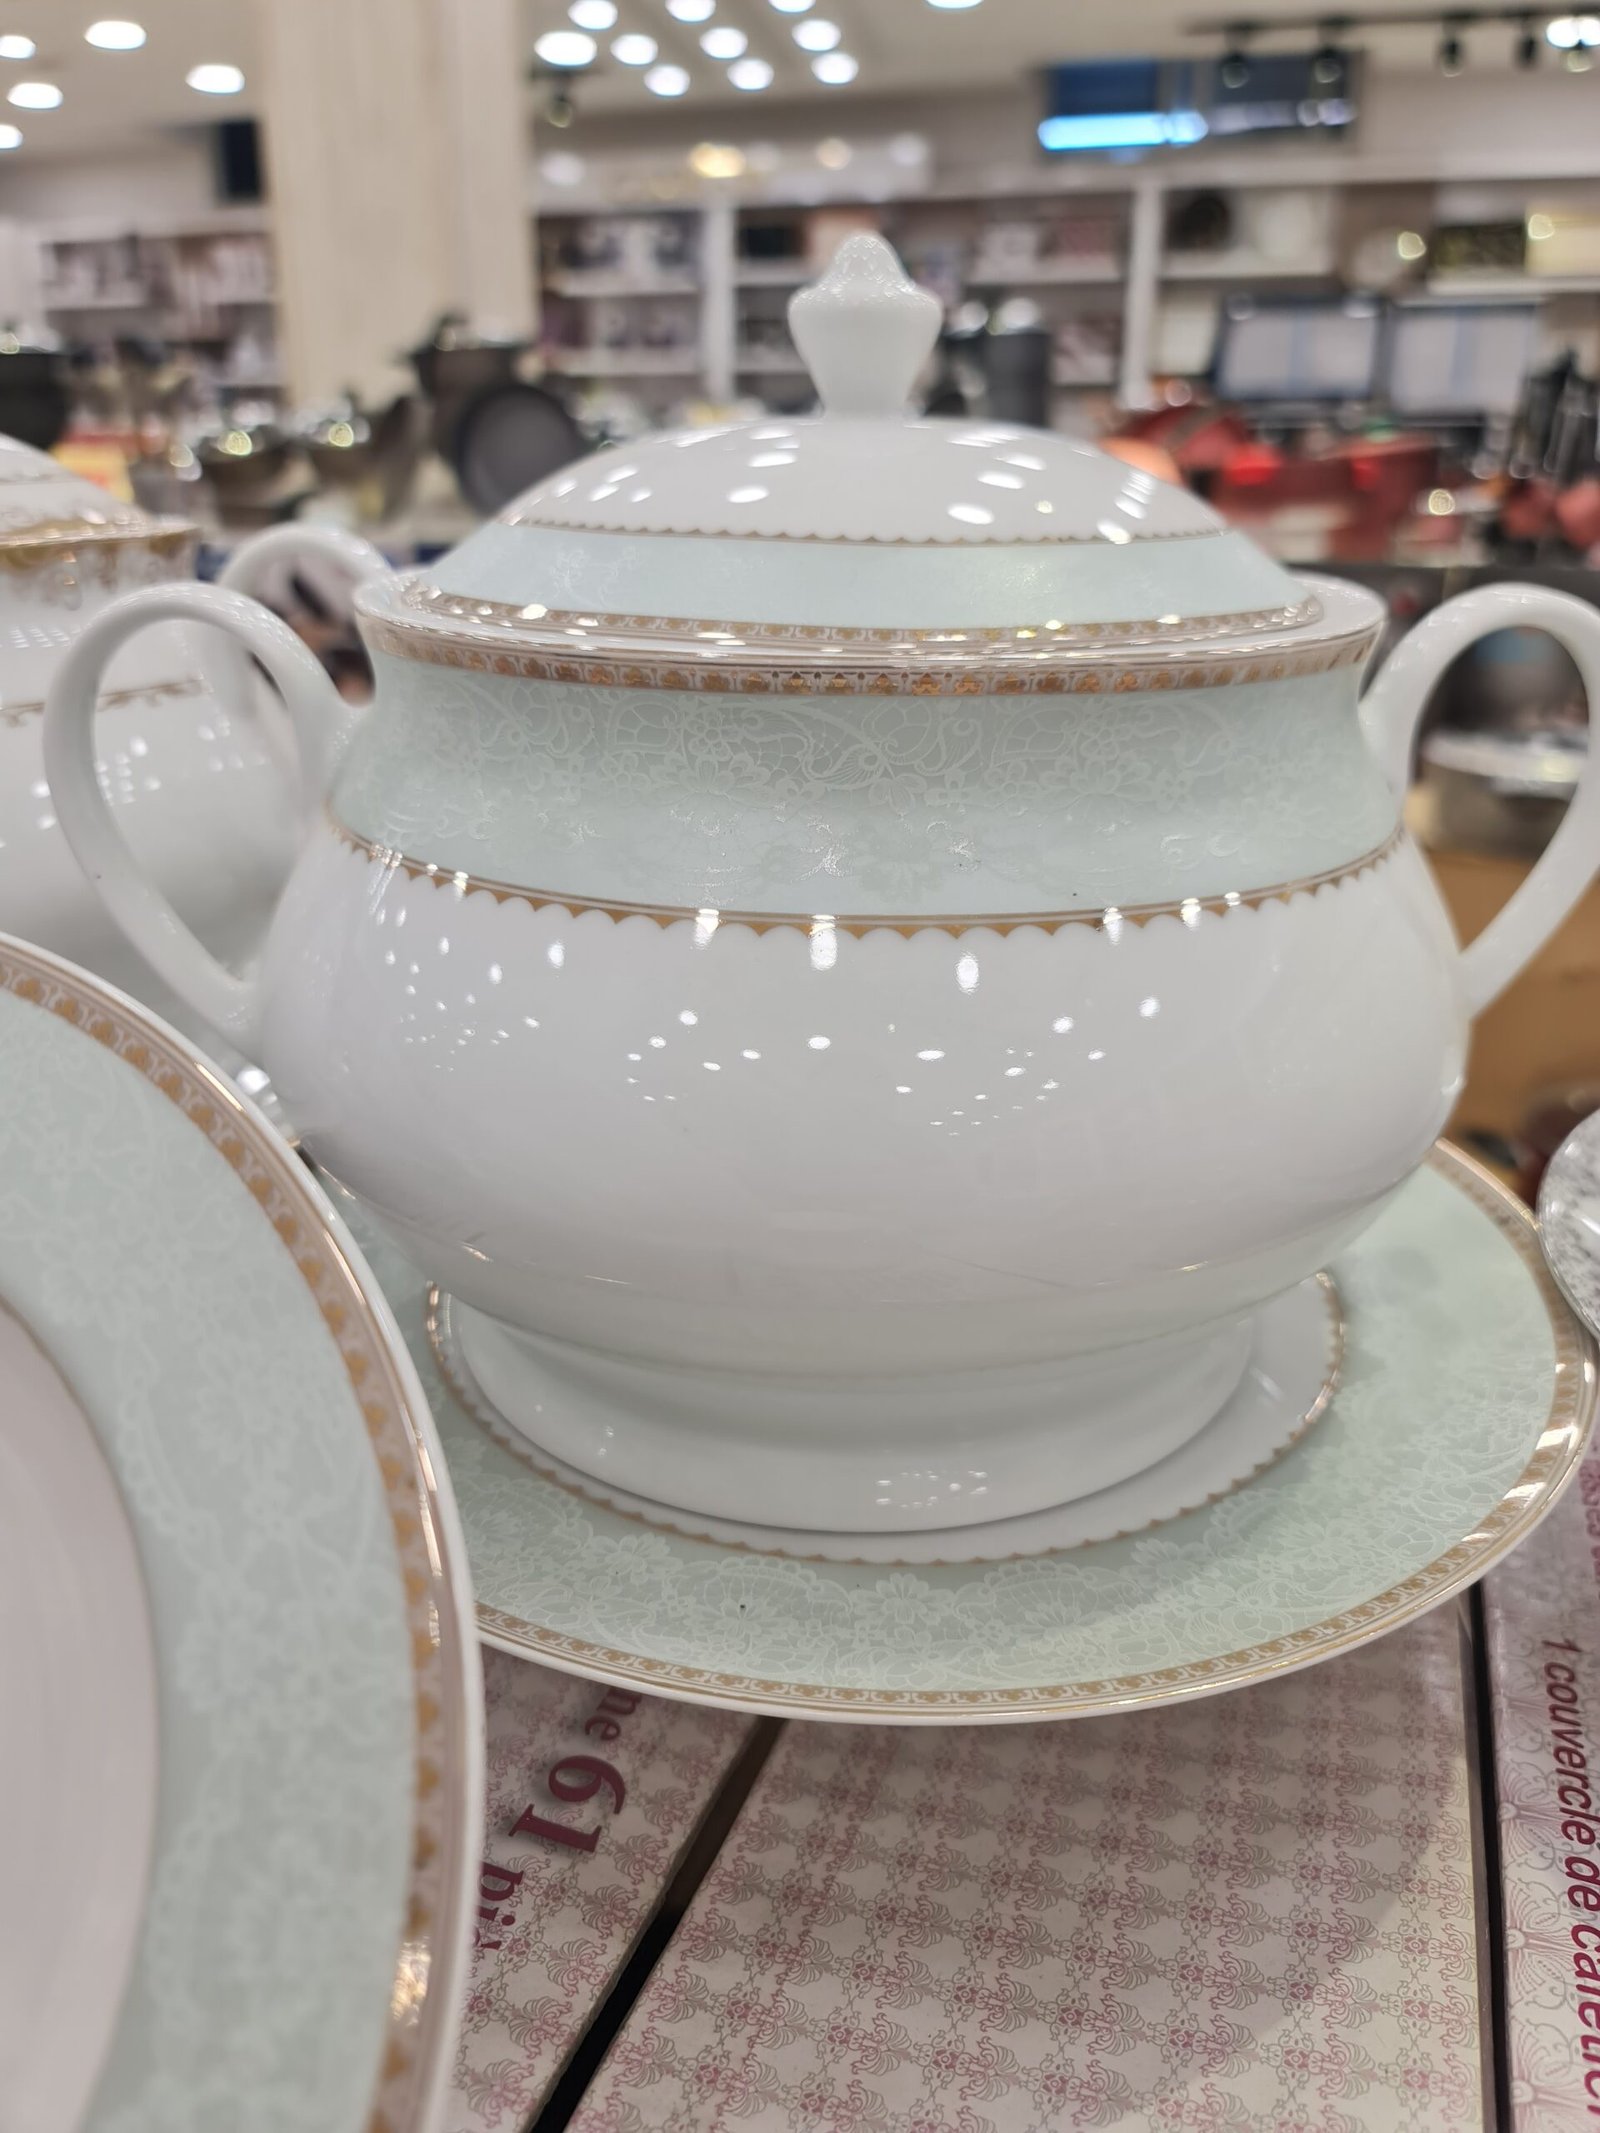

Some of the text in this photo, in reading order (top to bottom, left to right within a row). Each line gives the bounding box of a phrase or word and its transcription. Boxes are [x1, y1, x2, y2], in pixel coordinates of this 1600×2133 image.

[1543, 1660, 1600, 1846] couvercle
[507, 1754, 626, 1854] 61
[1564, 1855, 1600, 1912] de
